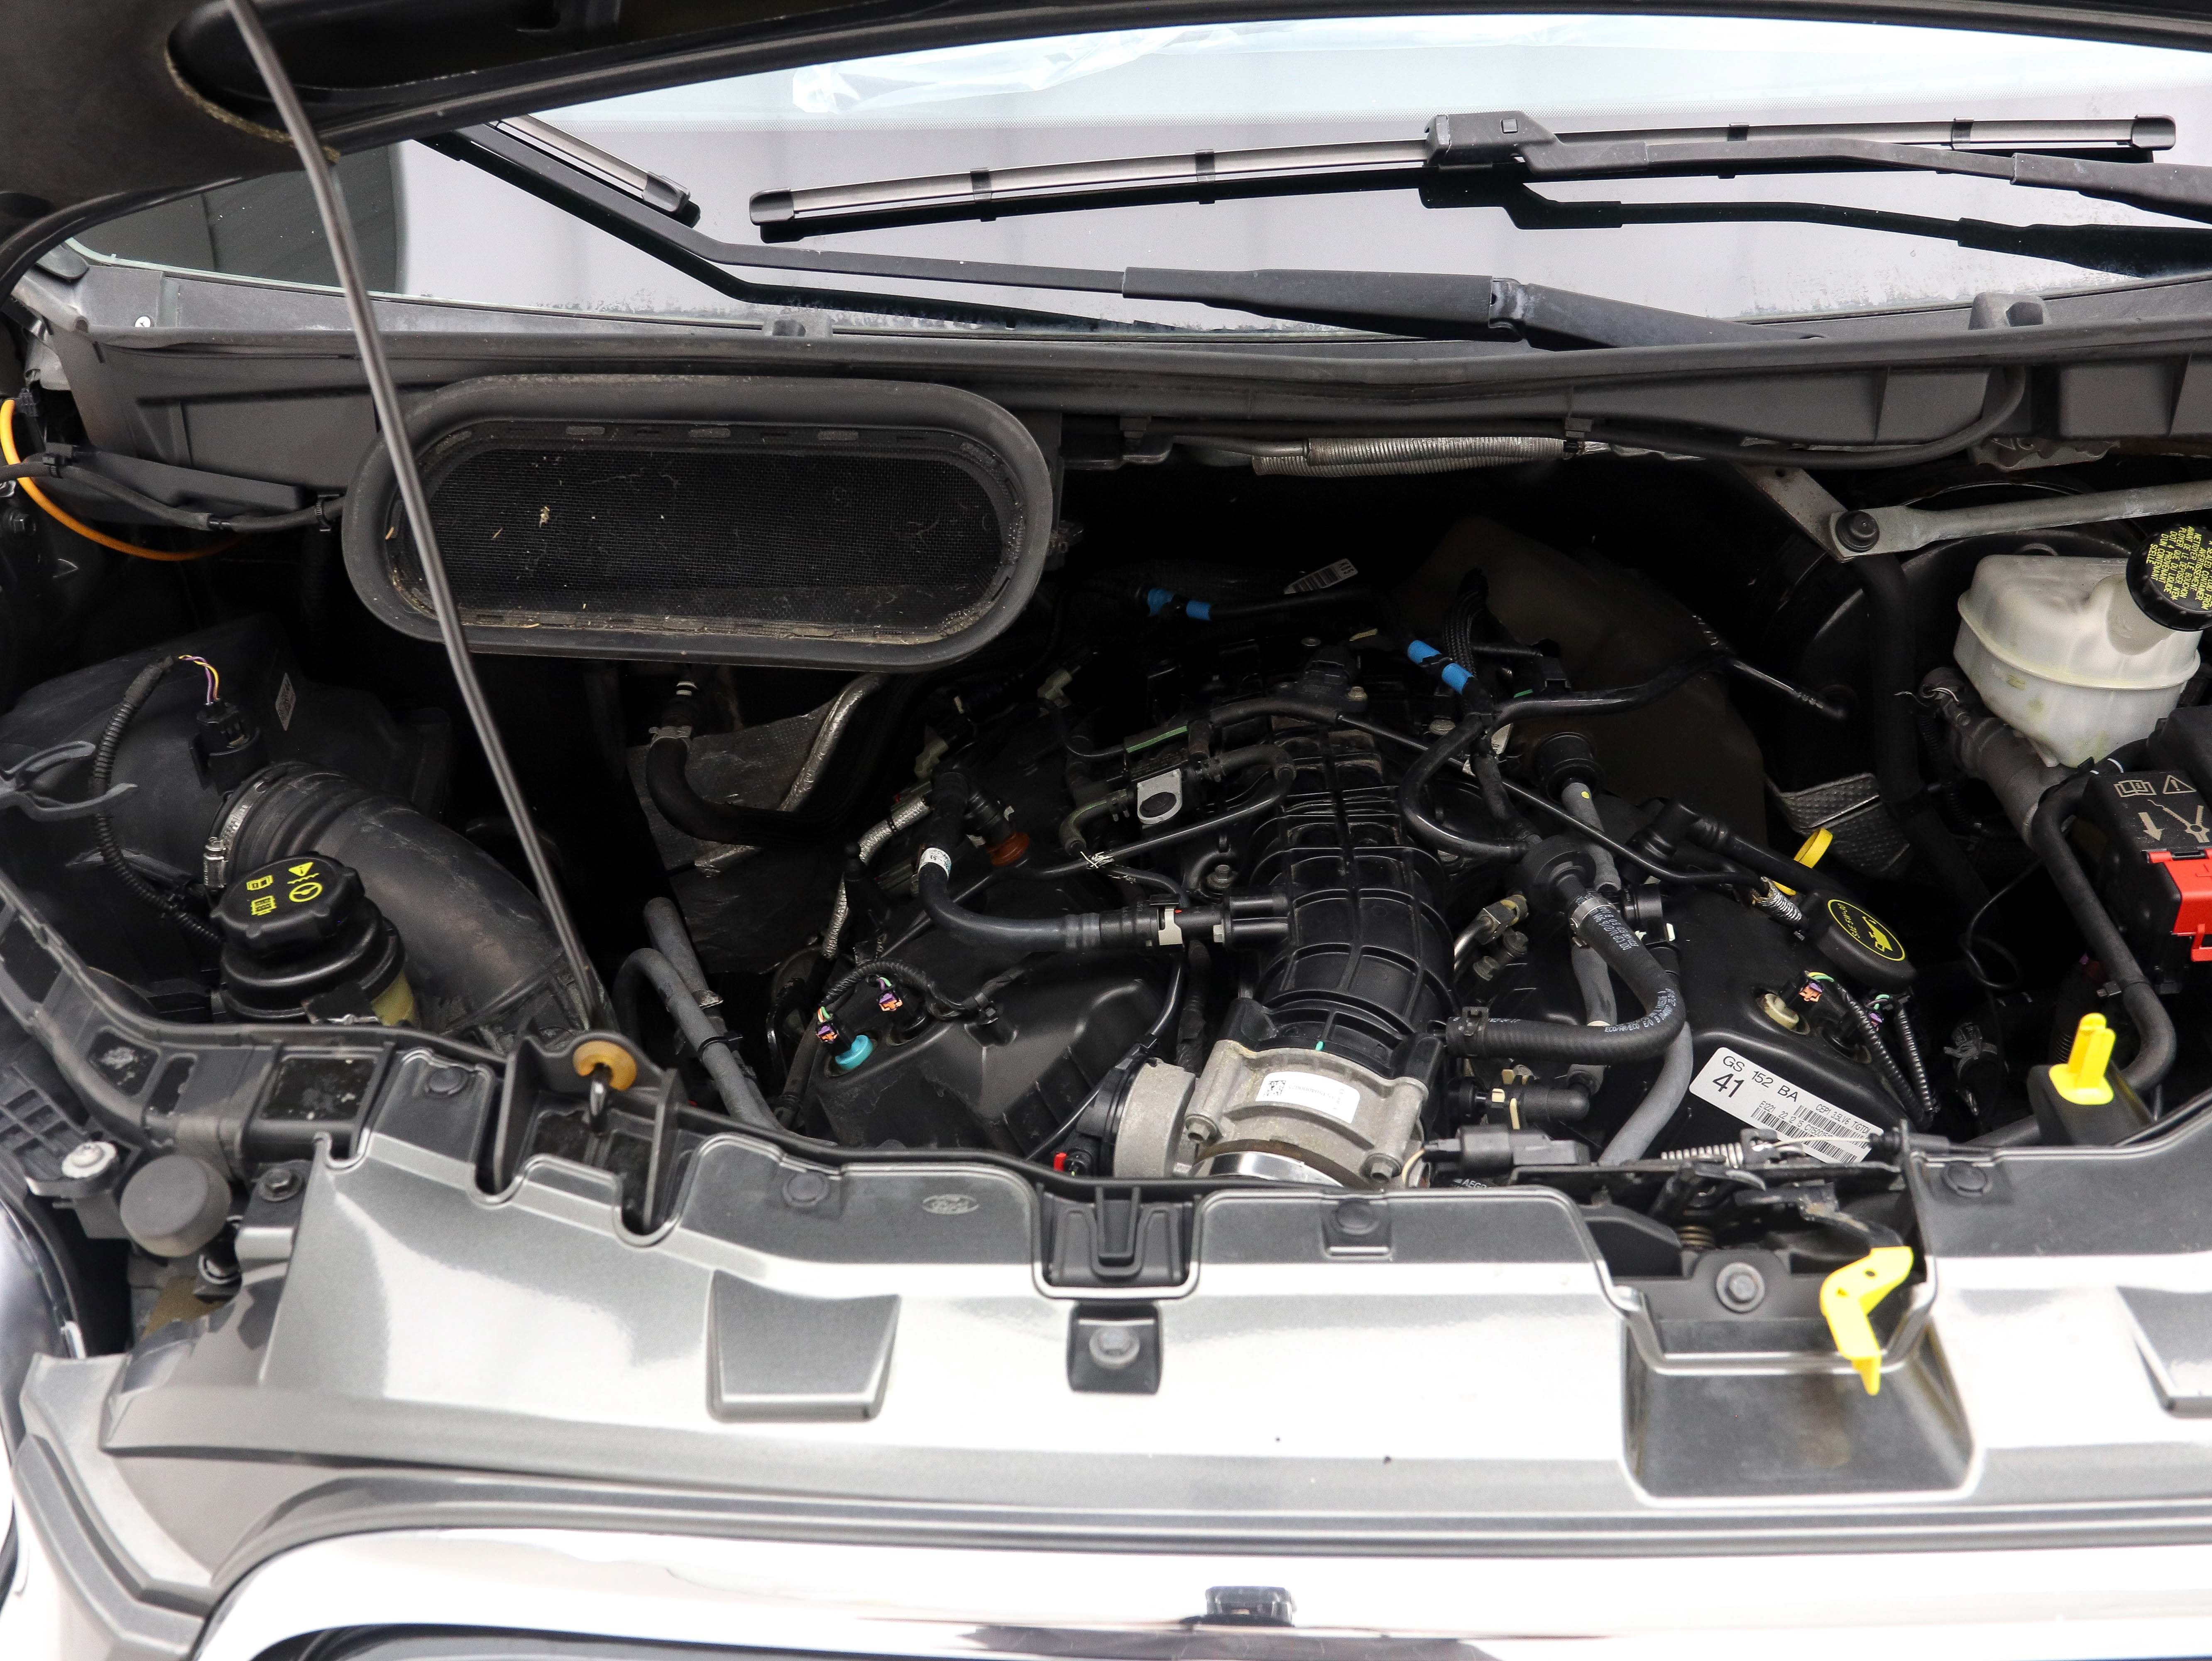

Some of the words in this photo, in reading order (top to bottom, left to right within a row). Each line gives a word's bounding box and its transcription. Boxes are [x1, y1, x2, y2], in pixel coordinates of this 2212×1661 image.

[2168, 531, 2178, 542] DOT
[2175, 527, 2187, 548] PLOYER
[2185, 526, 2195, 542] AVANT
[2172, 550, 2182, 561] QUE
[2190, 533, 2202, 561] NETTOYER
[2151, 548, 2165, 581] CONTENANT
[2158, 551, 2173, 583] PROVENANT
[2170, 563, 2178, 571] DU
[2188, 562, 2195, 571] LE
[2163, 573, 2175, 594] LIQUIDE
[2179, 572, 2192, 598] BOUCHON
[2201, 593, 2212, 610] FROM
[1713, 1073, 1745, 1098] 41
[1723, 1056, 1745, 1072] GS
[1751, 1071, 1774, 1088] 152
[1777, 1085, 1798, 1102] BA
[1759, 1100, 1775, 1112] E1221
[1779, 1111, 1789, 1120] 22
[1816, 1104, 1830, 1116] CEP1
